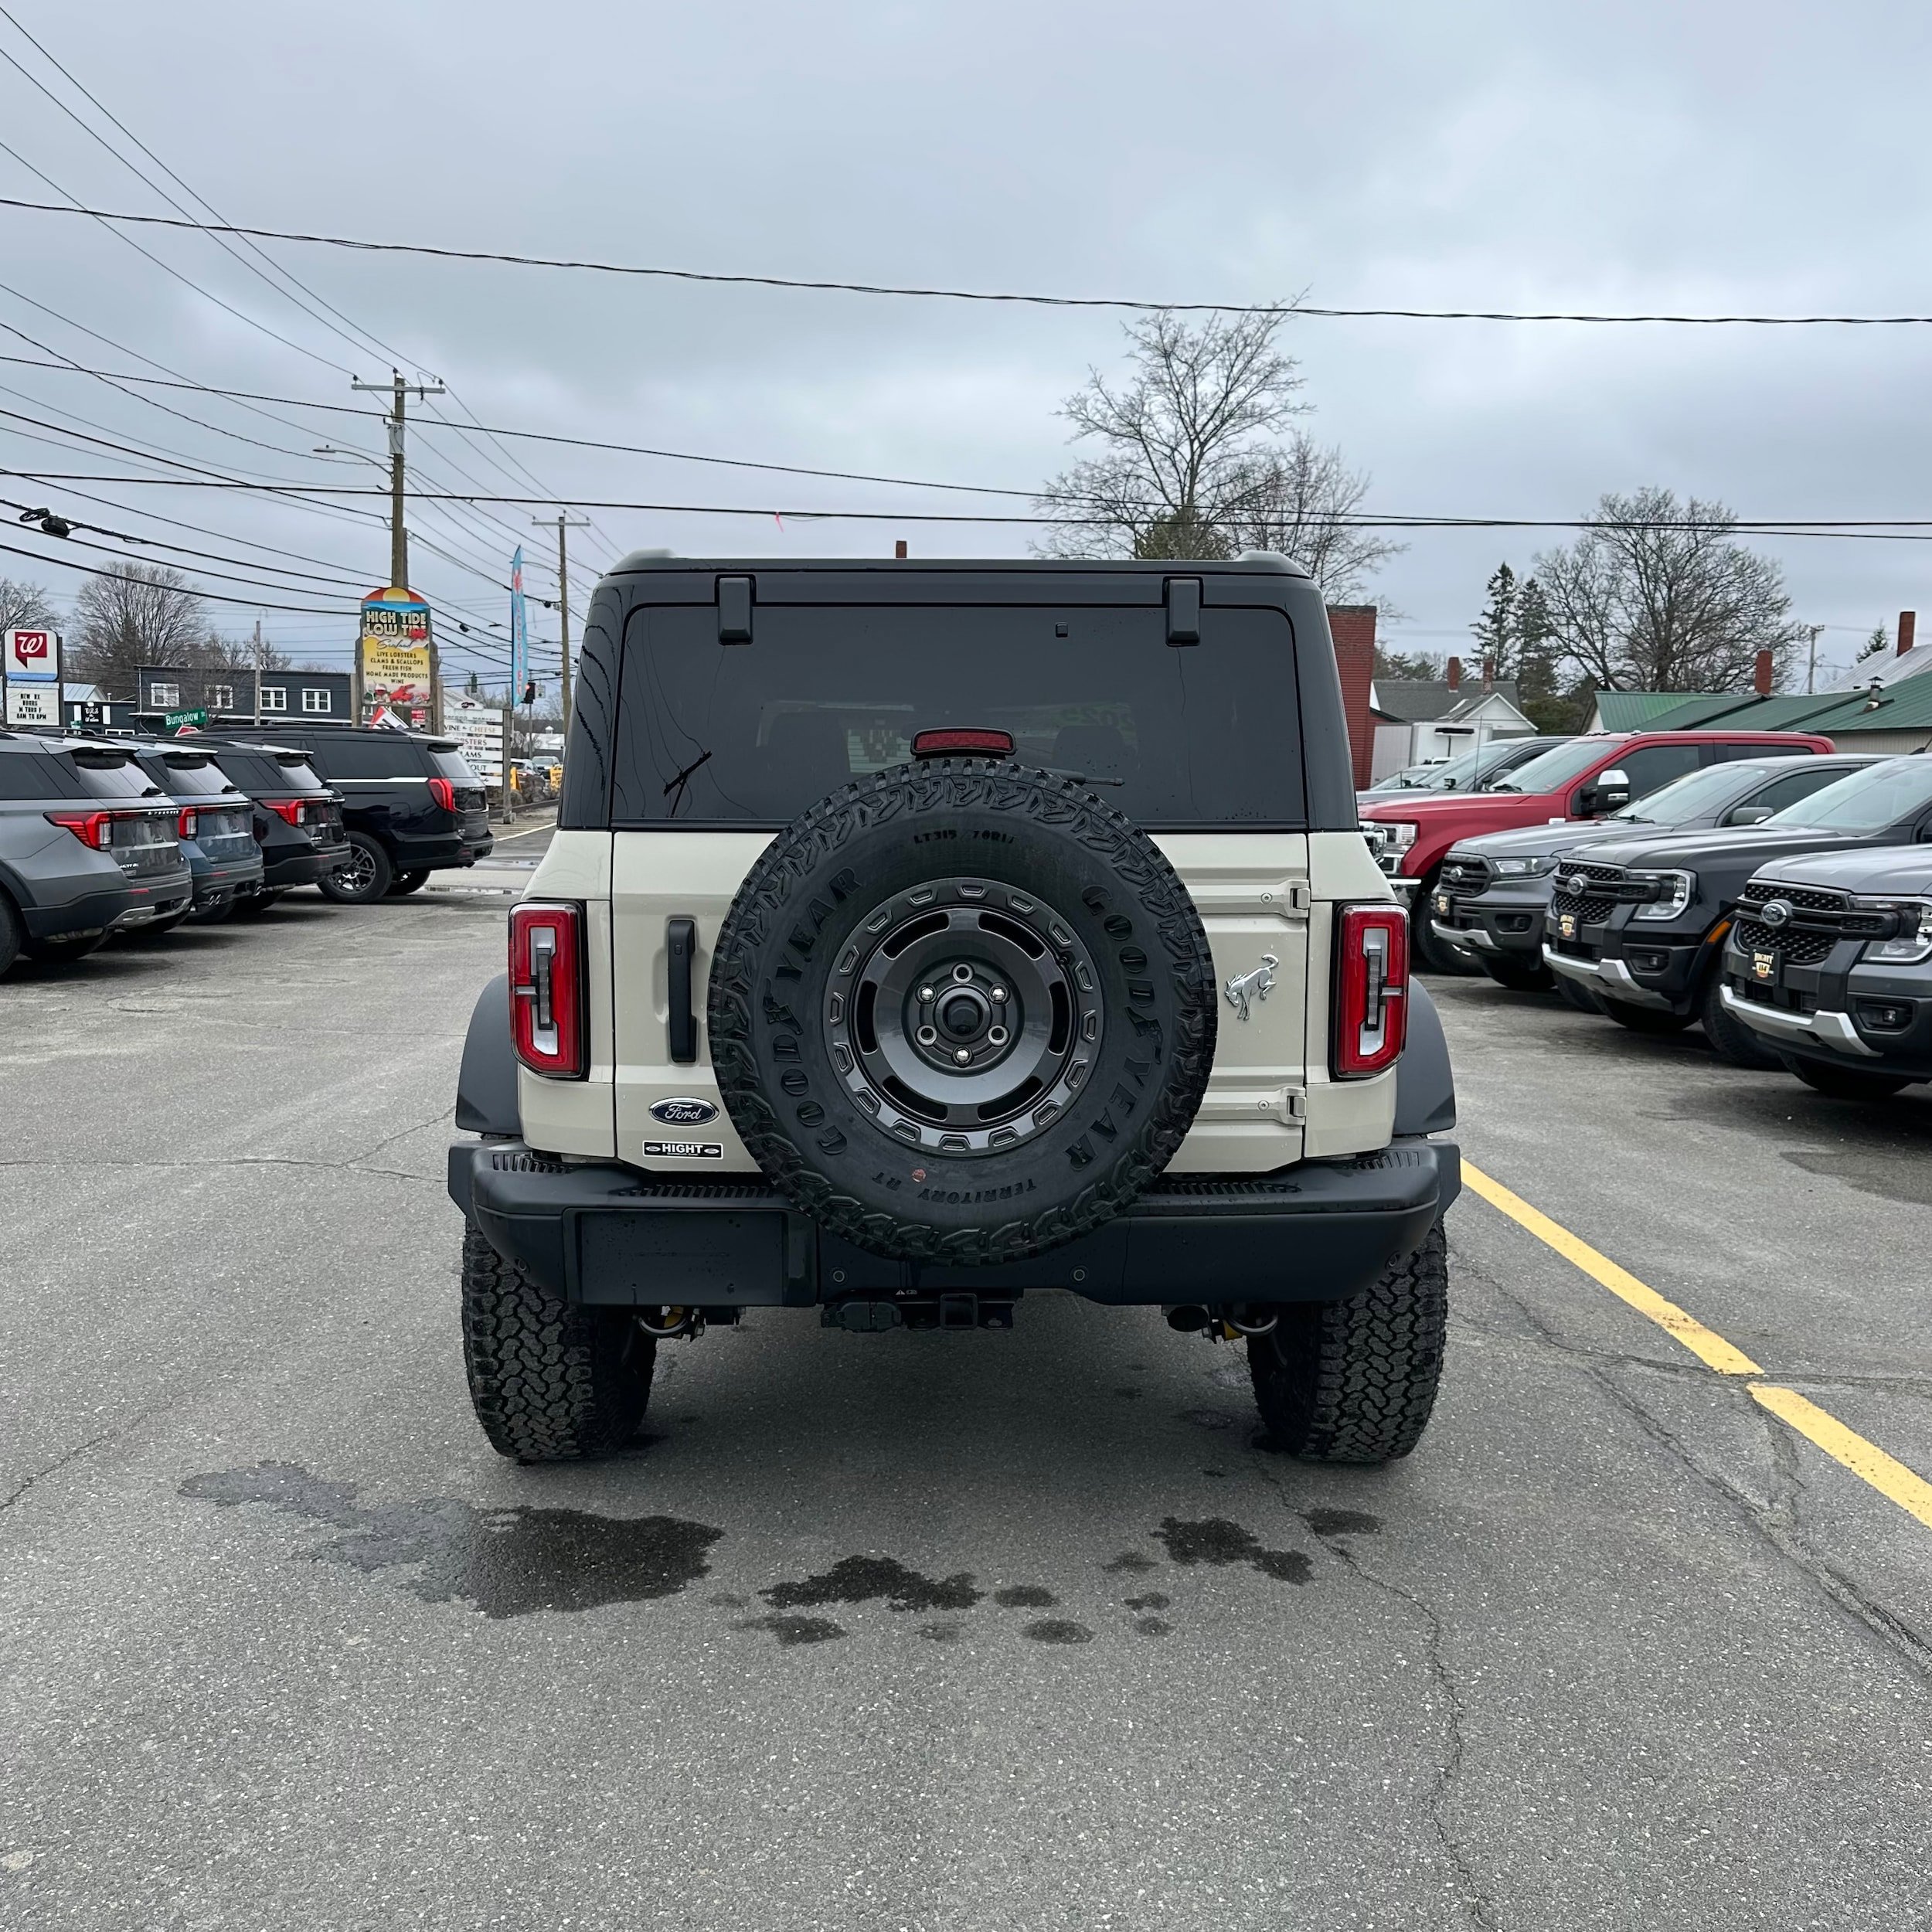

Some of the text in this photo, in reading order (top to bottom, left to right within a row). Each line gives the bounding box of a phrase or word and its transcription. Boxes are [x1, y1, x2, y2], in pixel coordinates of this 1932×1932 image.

[366, 611, 427, 624] HIGH TIDE
[366, 623, 398, 636] LOW
[165, 712, 199, 726] Bungalow
[665, 1104, 702, 1120] Ford
[662, 1144, 703, 1154] HIGHT
[917, 1178, 1038, 1204] TERRITORY
